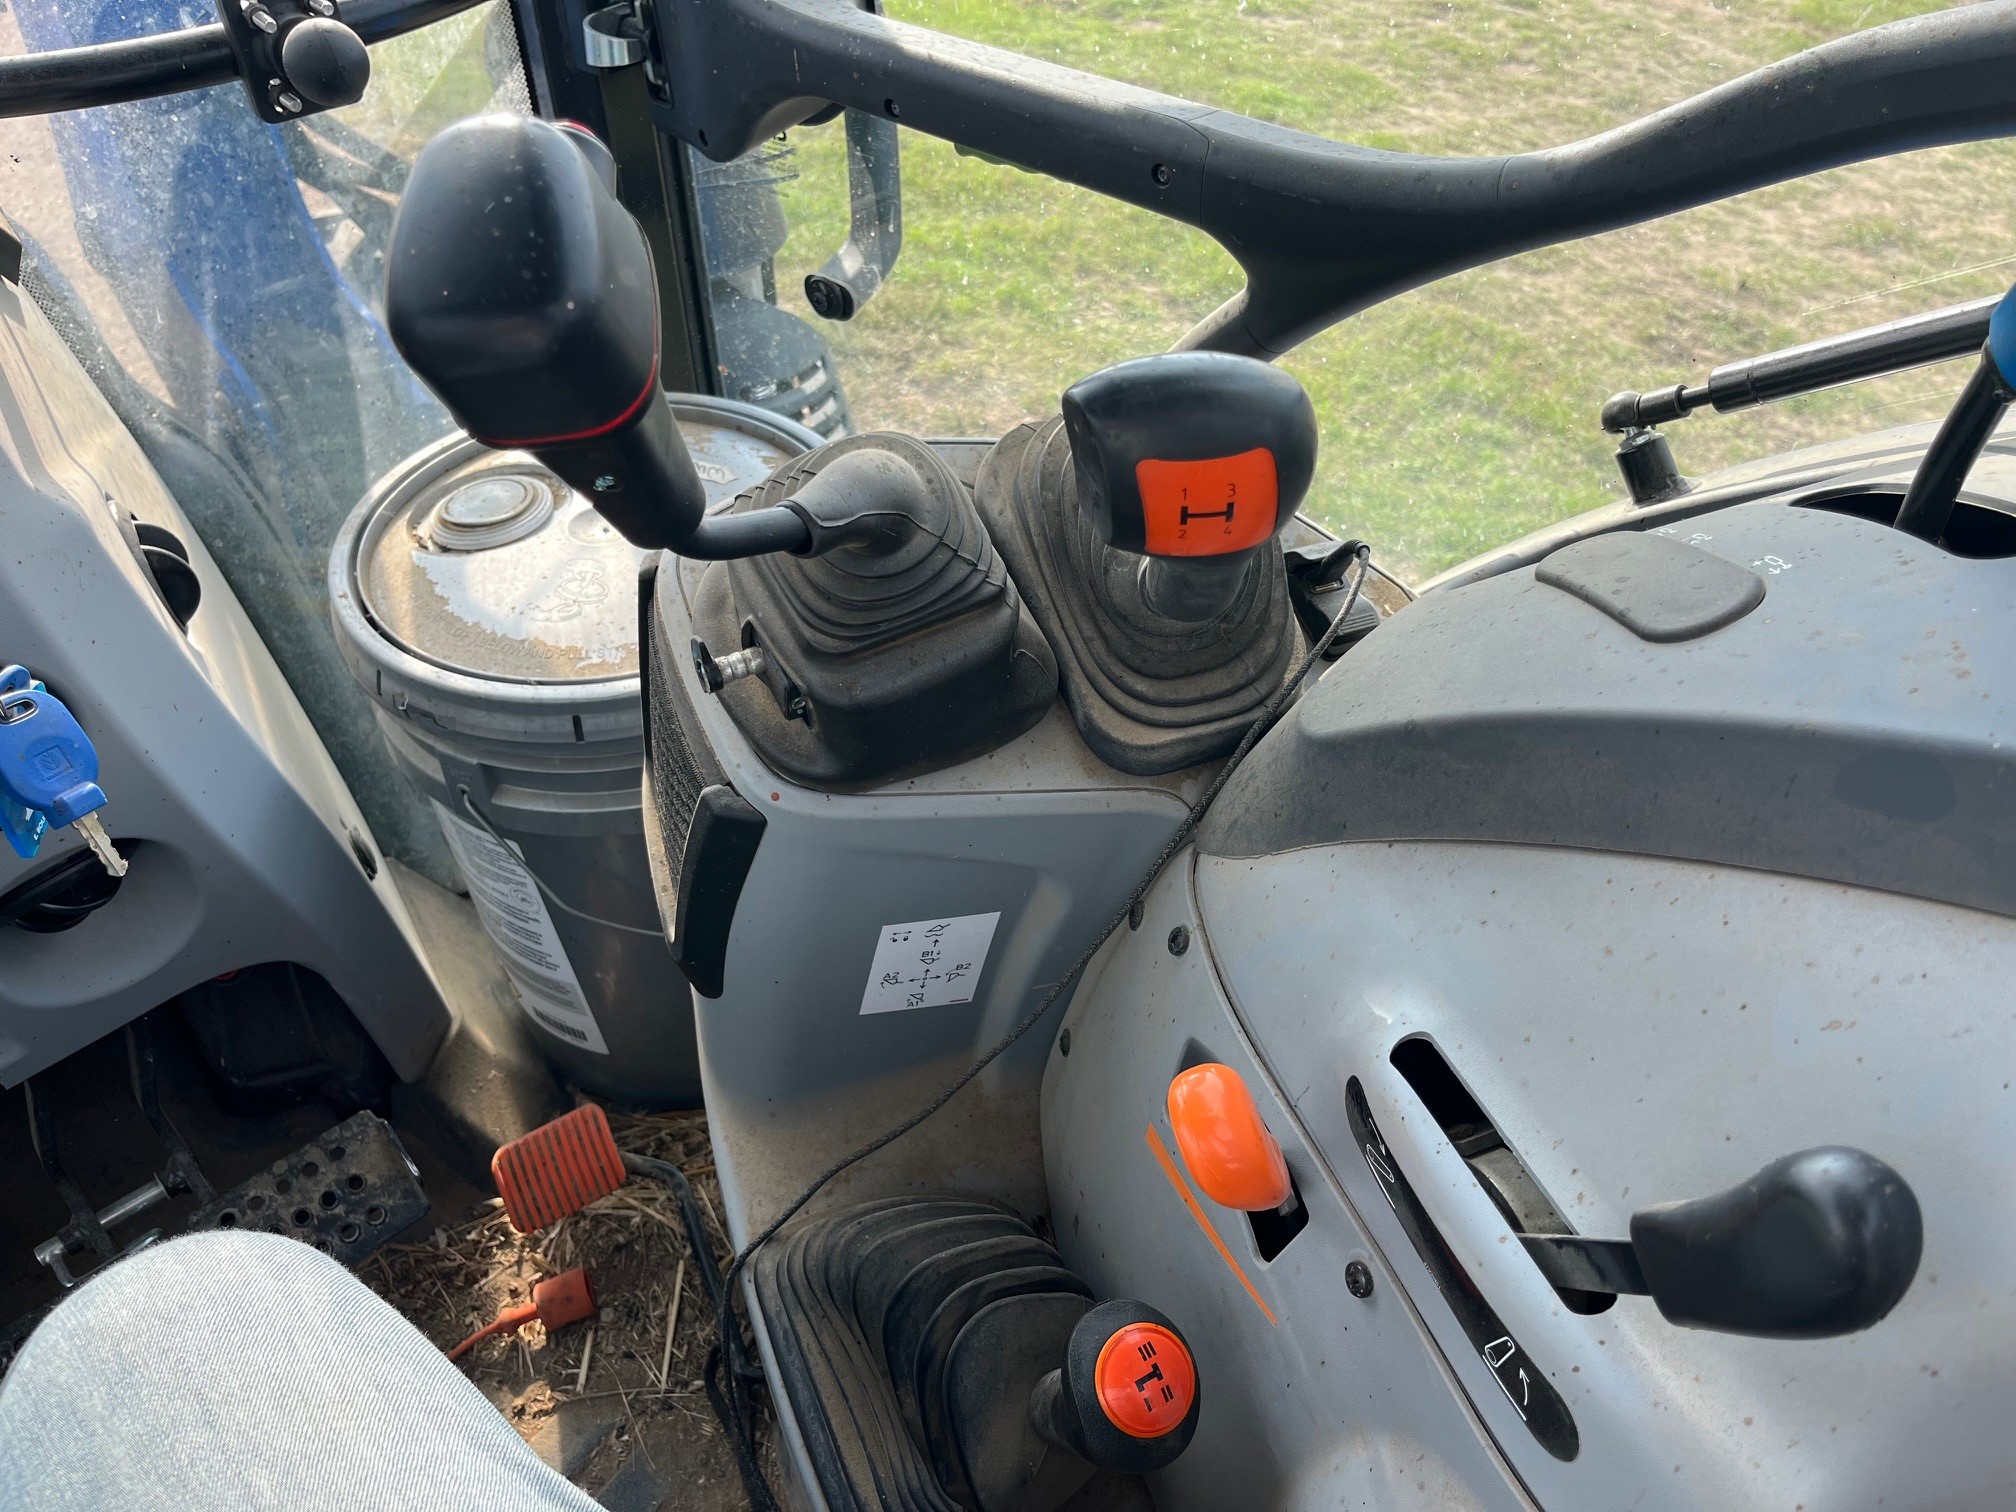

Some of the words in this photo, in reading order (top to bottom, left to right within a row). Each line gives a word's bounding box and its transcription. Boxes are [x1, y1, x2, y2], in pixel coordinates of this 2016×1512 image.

[1181, 487, 1188, 501] 1
[1227, 483, 1236, 498] 3
[1178, 529, 1188, 539] 2
[1223, 526, 1232, 535] 4
[525, 645, 554, 660] AND
[558, 647, 593, 660] PULL
[921, 950, 934, 958] B1
[955, 963, 972, 971] B2
[883, 971, 900, 980] A2
